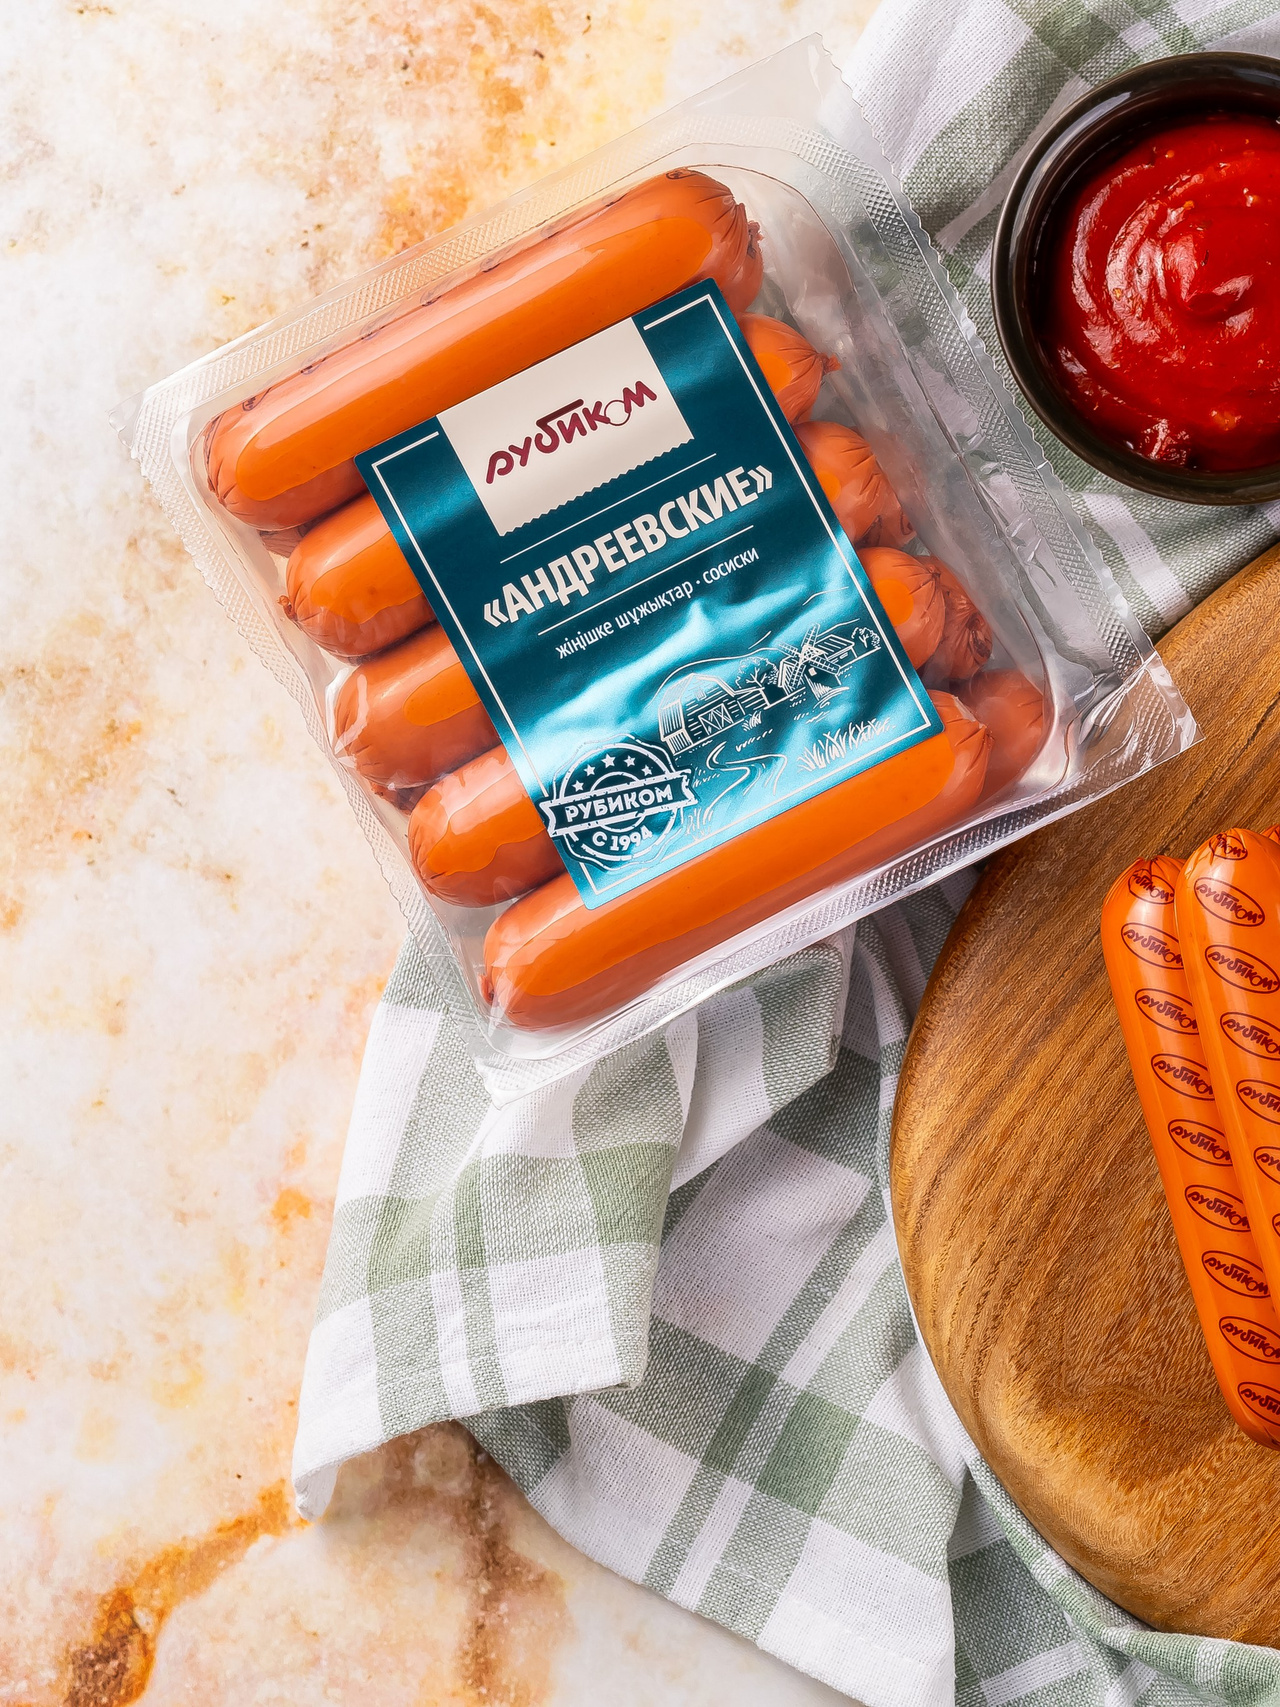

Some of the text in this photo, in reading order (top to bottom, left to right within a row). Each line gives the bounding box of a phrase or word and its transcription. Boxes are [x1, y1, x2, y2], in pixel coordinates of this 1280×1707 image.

[484, 465, 773, 628] «АНДРЕЕВСКИЕ»
[615, 580, 693, 627] шұжықтар
[702, 547, 760, 585] сосиски
[565, 784, 673, 822] РУБИКОМ
[592, 825, 653, 851] С 1994
